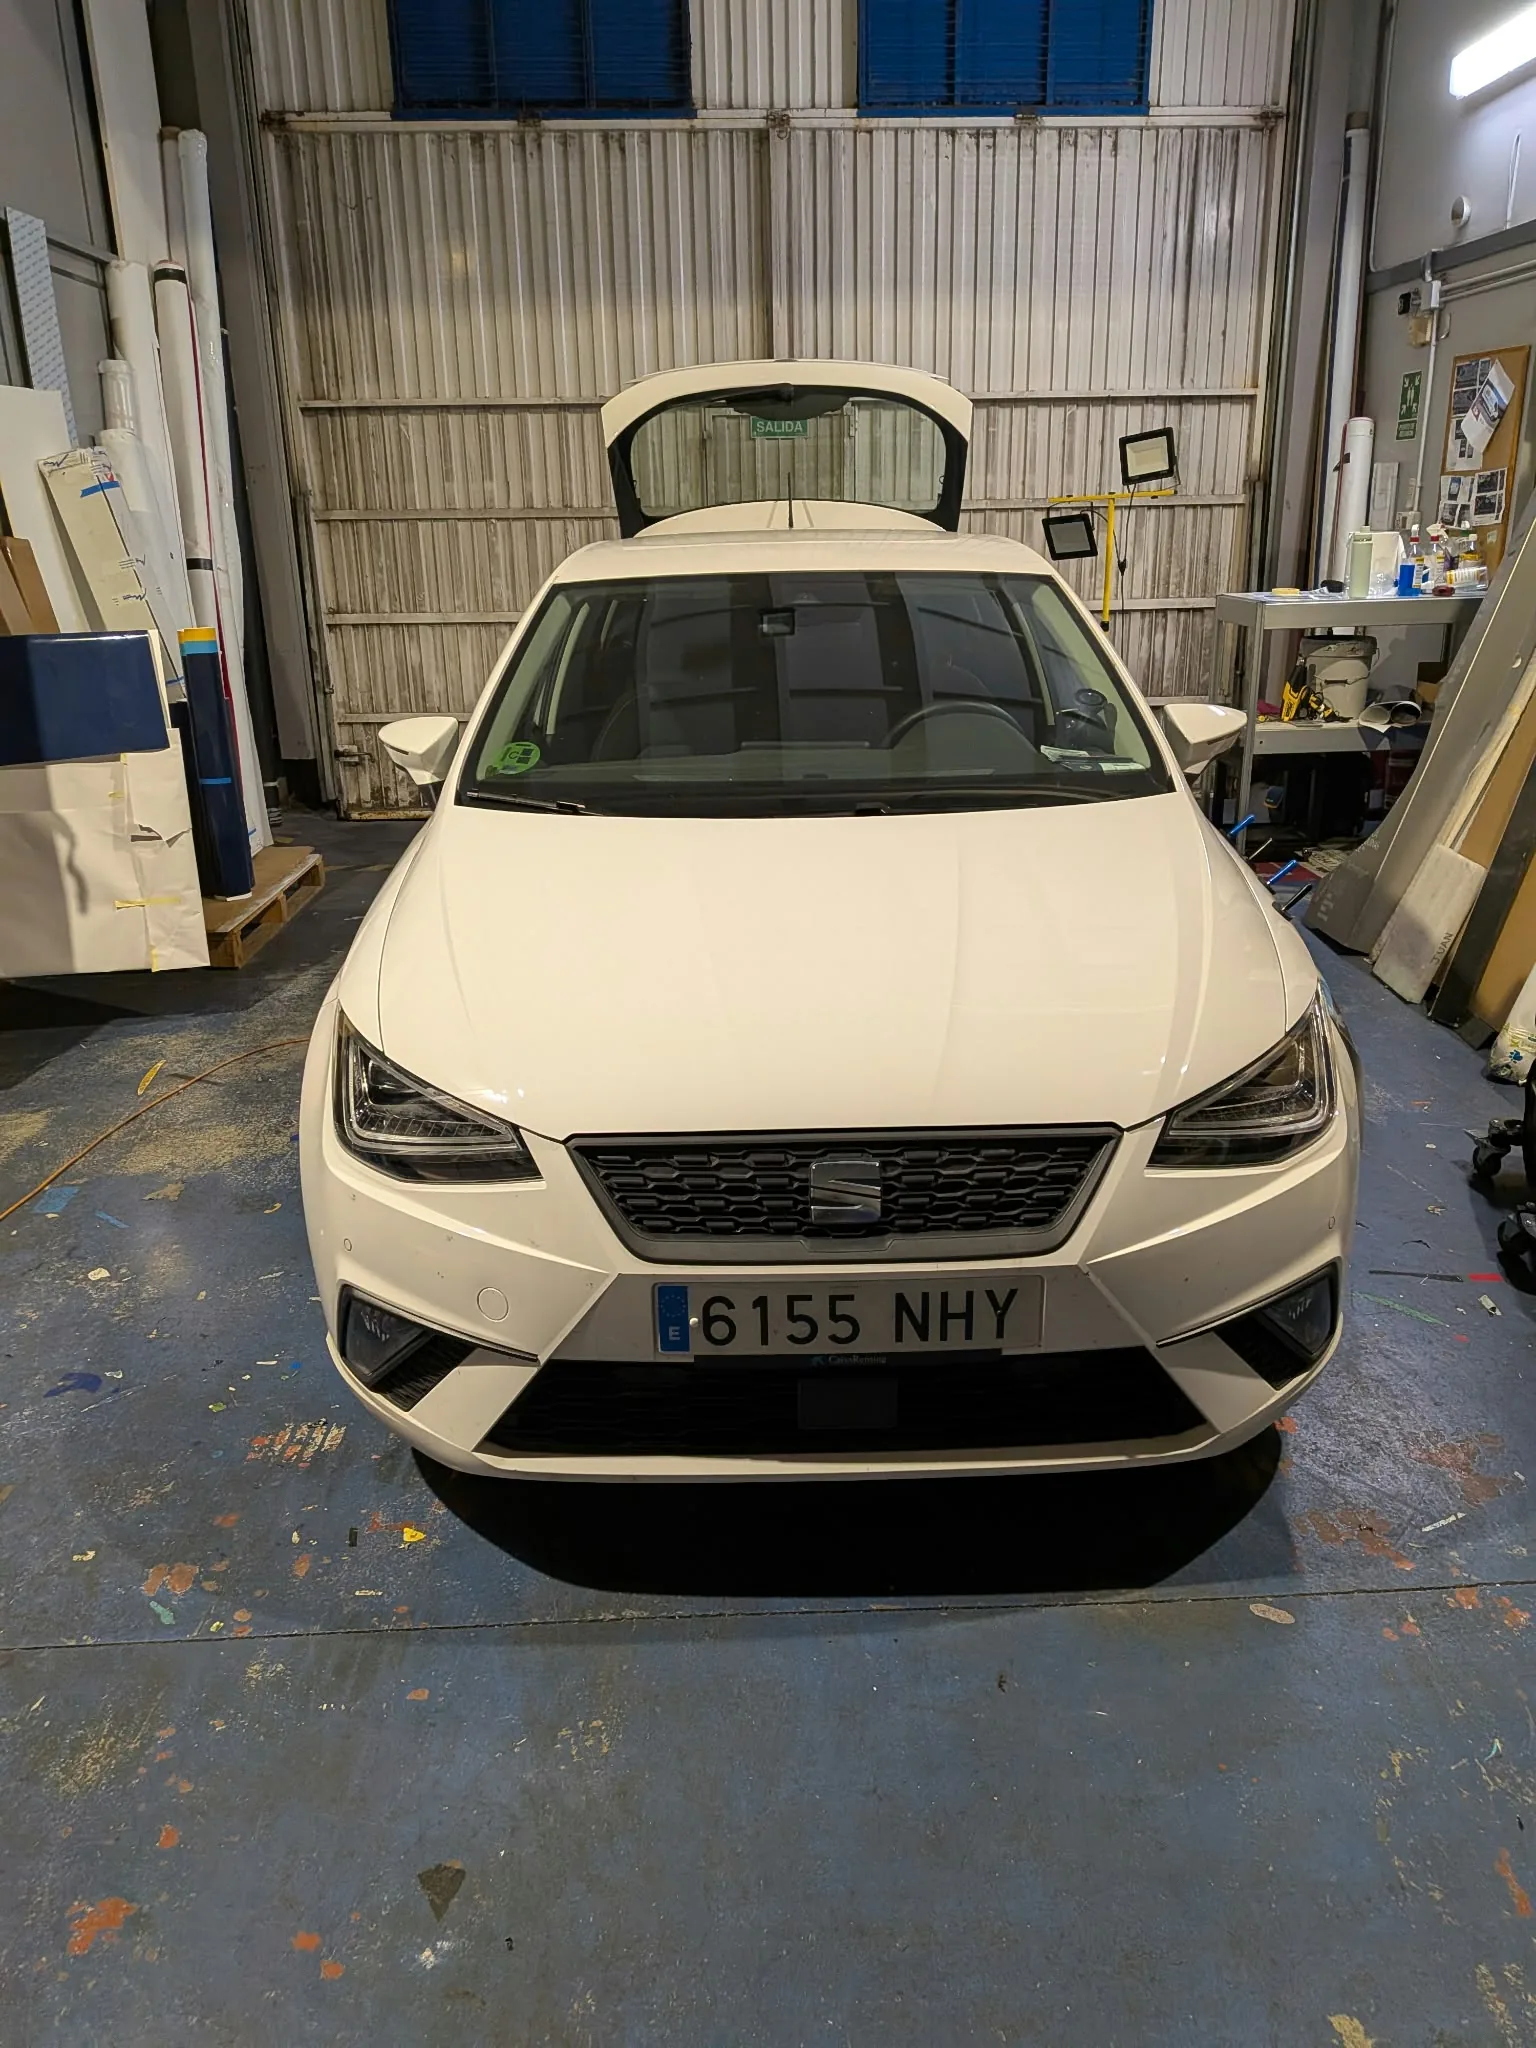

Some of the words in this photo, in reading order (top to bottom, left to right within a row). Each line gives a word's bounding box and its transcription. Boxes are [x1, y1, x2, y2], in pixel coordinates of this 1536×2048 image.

[756, 421, 803, 432] SALIDA
[508, 750, 520, 760] C
[1430, 932, 1453, 965] JUAN
[668, 1326, 681, 1341] E
[702, 1295, 861, 1346] 6155
[895, 1288, 1019, 1343] NHY
